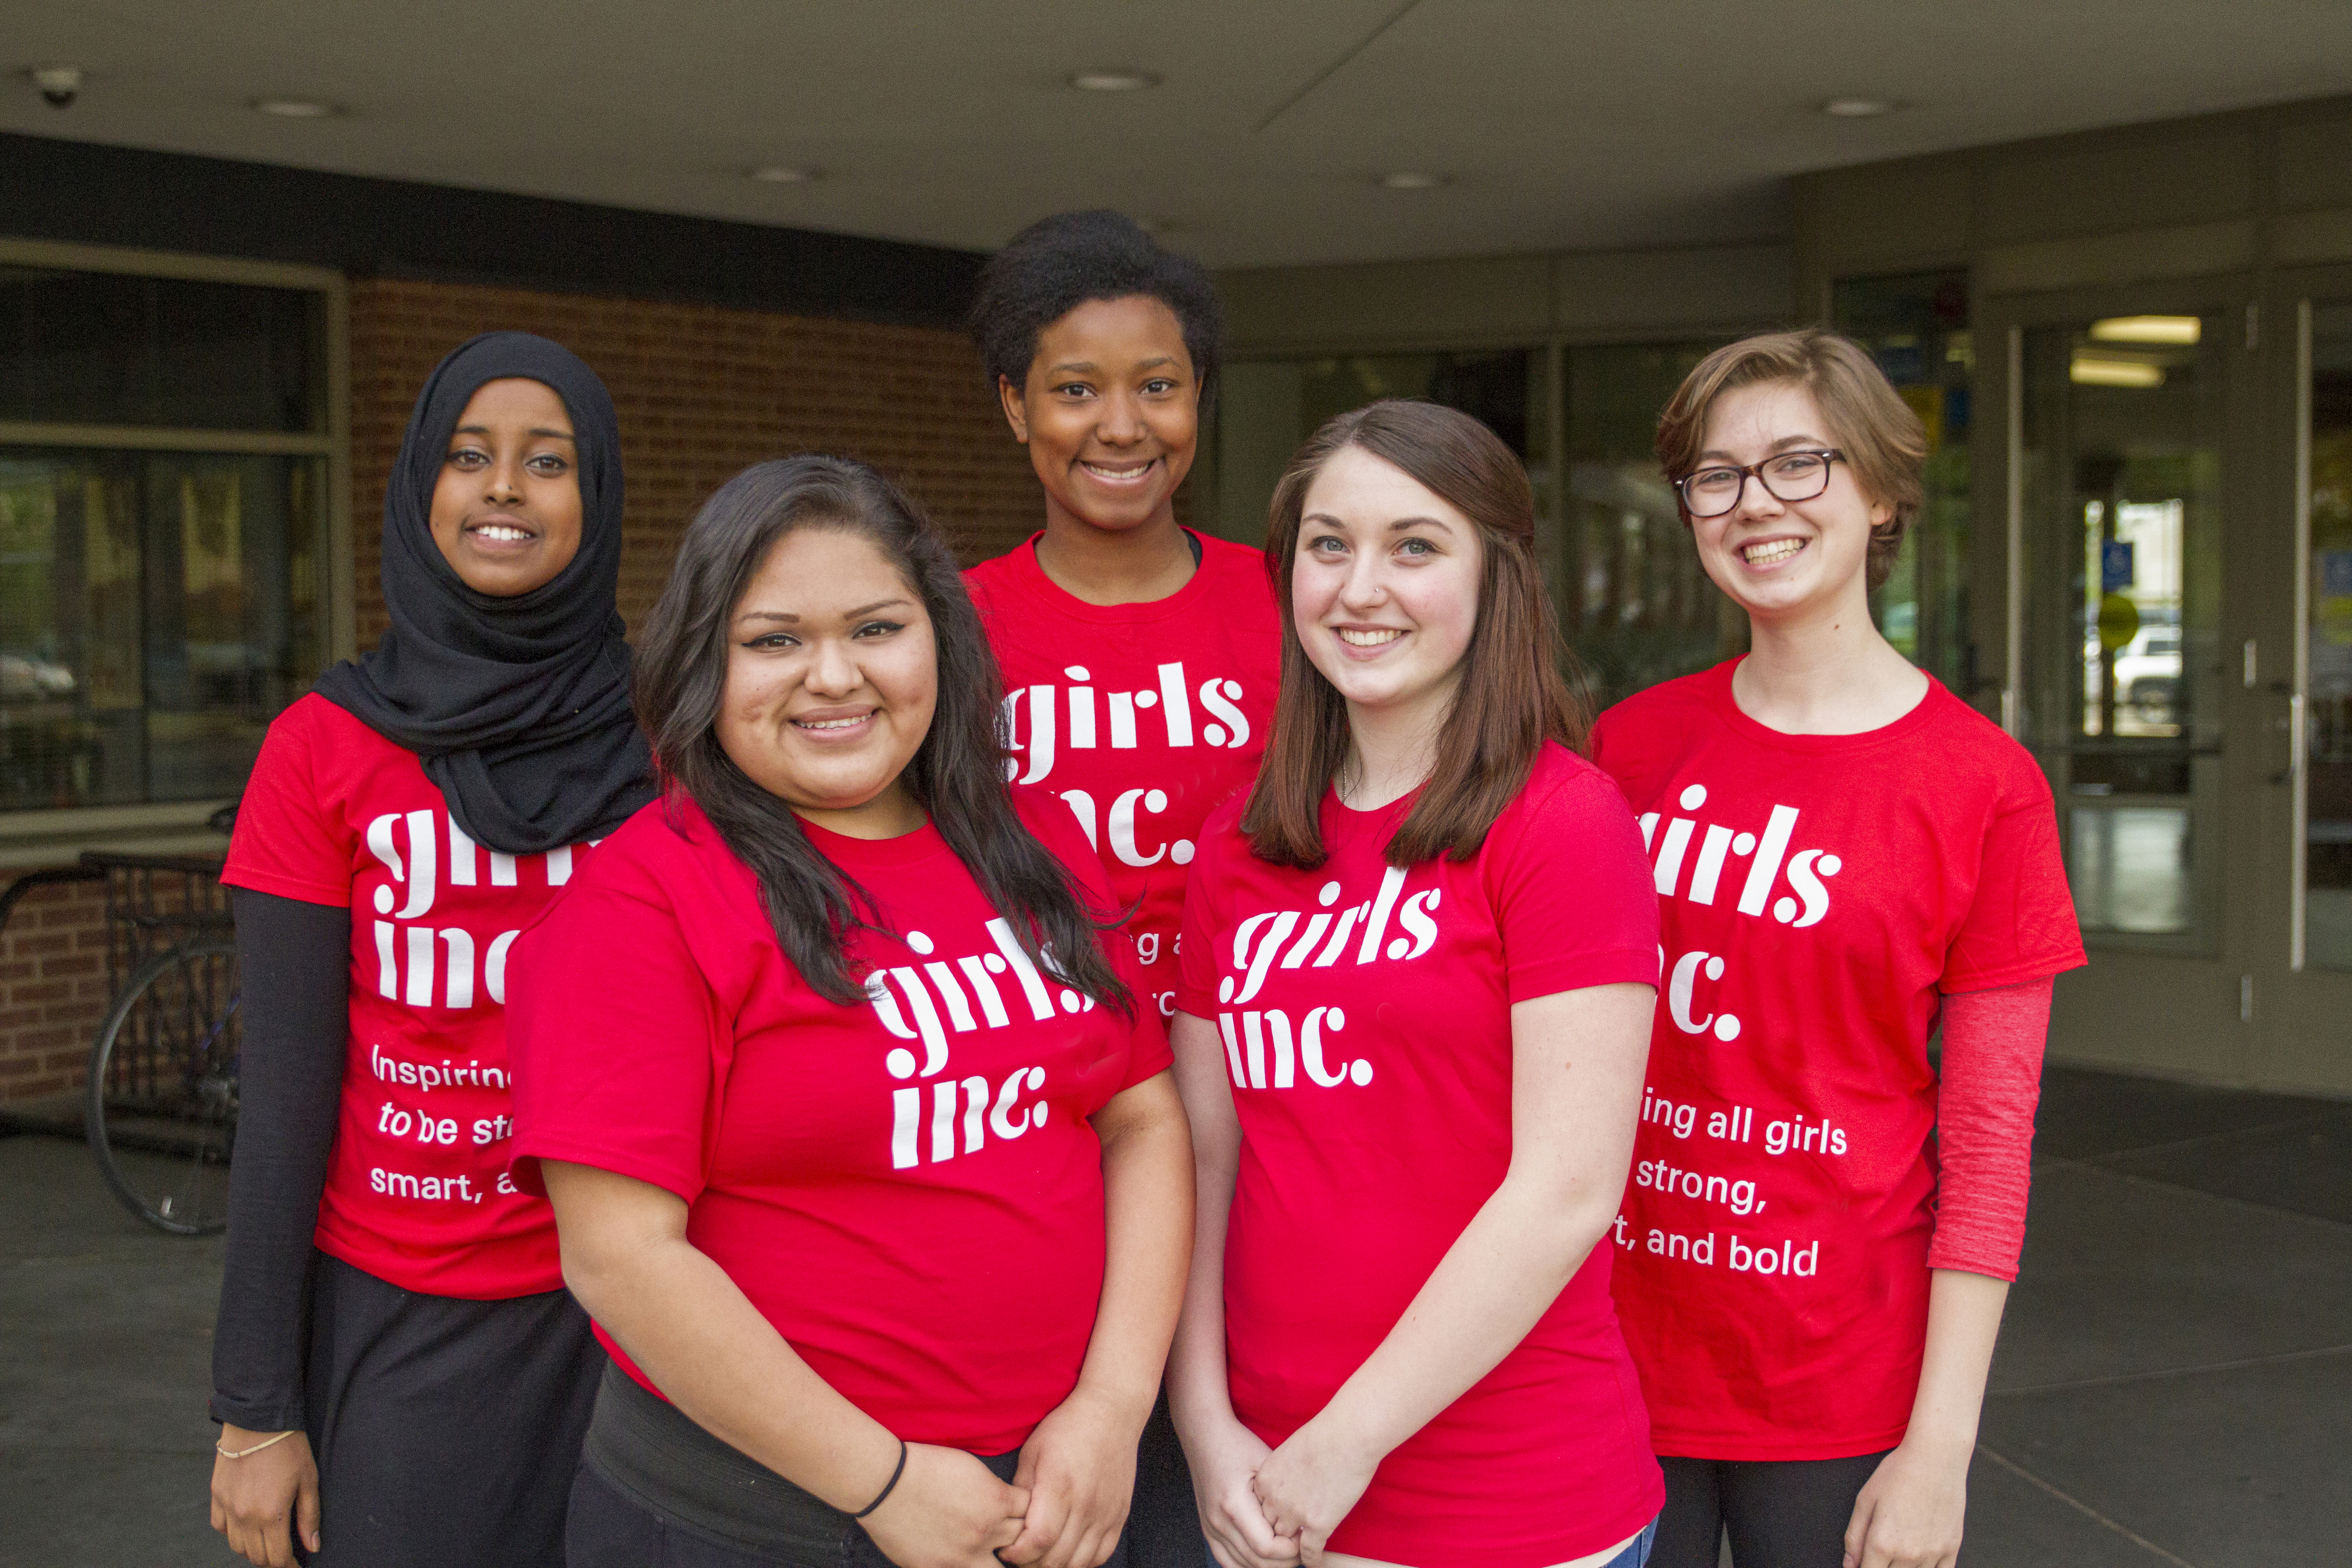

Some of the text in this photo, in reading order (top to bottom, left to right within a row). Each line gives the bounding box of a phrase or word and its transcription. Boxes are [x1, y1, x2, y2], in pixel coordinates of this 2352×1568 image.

[995, 661, 1250, 785] girls
[1049, 789, 1196, 867] c.
[1634, 784, 1842, 927] irls
[374, 919, 521, 1008] inc
[1219, 866, 1441, 1004] girls
[372, 1044, 511, 1092] Inspirin
[1219, 1006, 1373, 1089] inc.
[378, 1102, 412, 1136] to
[417, 1109, 458, 1145] be
[892, 1066, 1049, 1170] inc.
[1707, 1106, 1753, 1143] all
[1765, 1114, 1847, 1155] girls
[371, 1167, 483, 1204] smart,
[1636, 1159, 1766, 1215] strong,
[1646, 1229, 1714, 1265] and
[1729, 1235, 1818, 1276] bold
